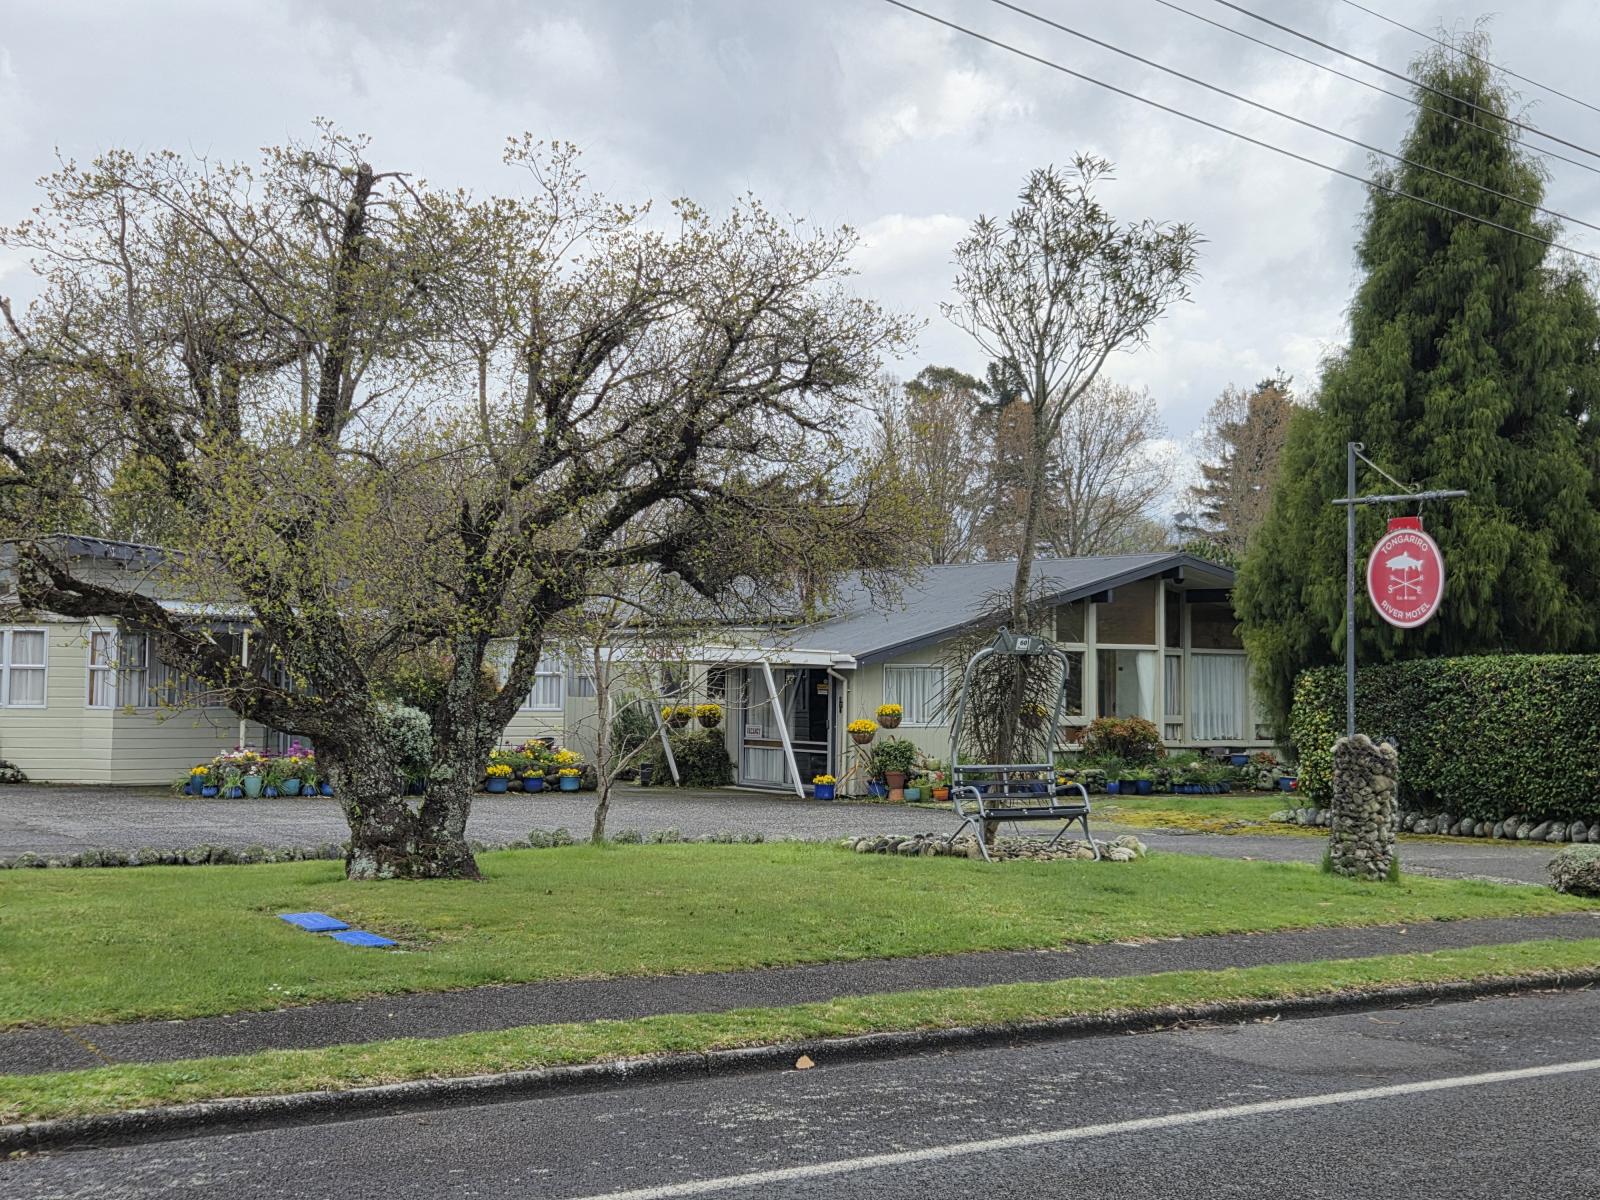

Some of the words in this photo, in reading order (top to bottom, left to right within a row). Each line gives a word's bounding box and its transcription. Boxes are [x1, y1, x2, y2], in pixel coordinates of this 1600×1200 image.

[1381, 535, 1428, 554] TONGARIRO
[1381, 600, 1402, 618] RIVER
[1406, 602, 1431, 619] MOTEL
